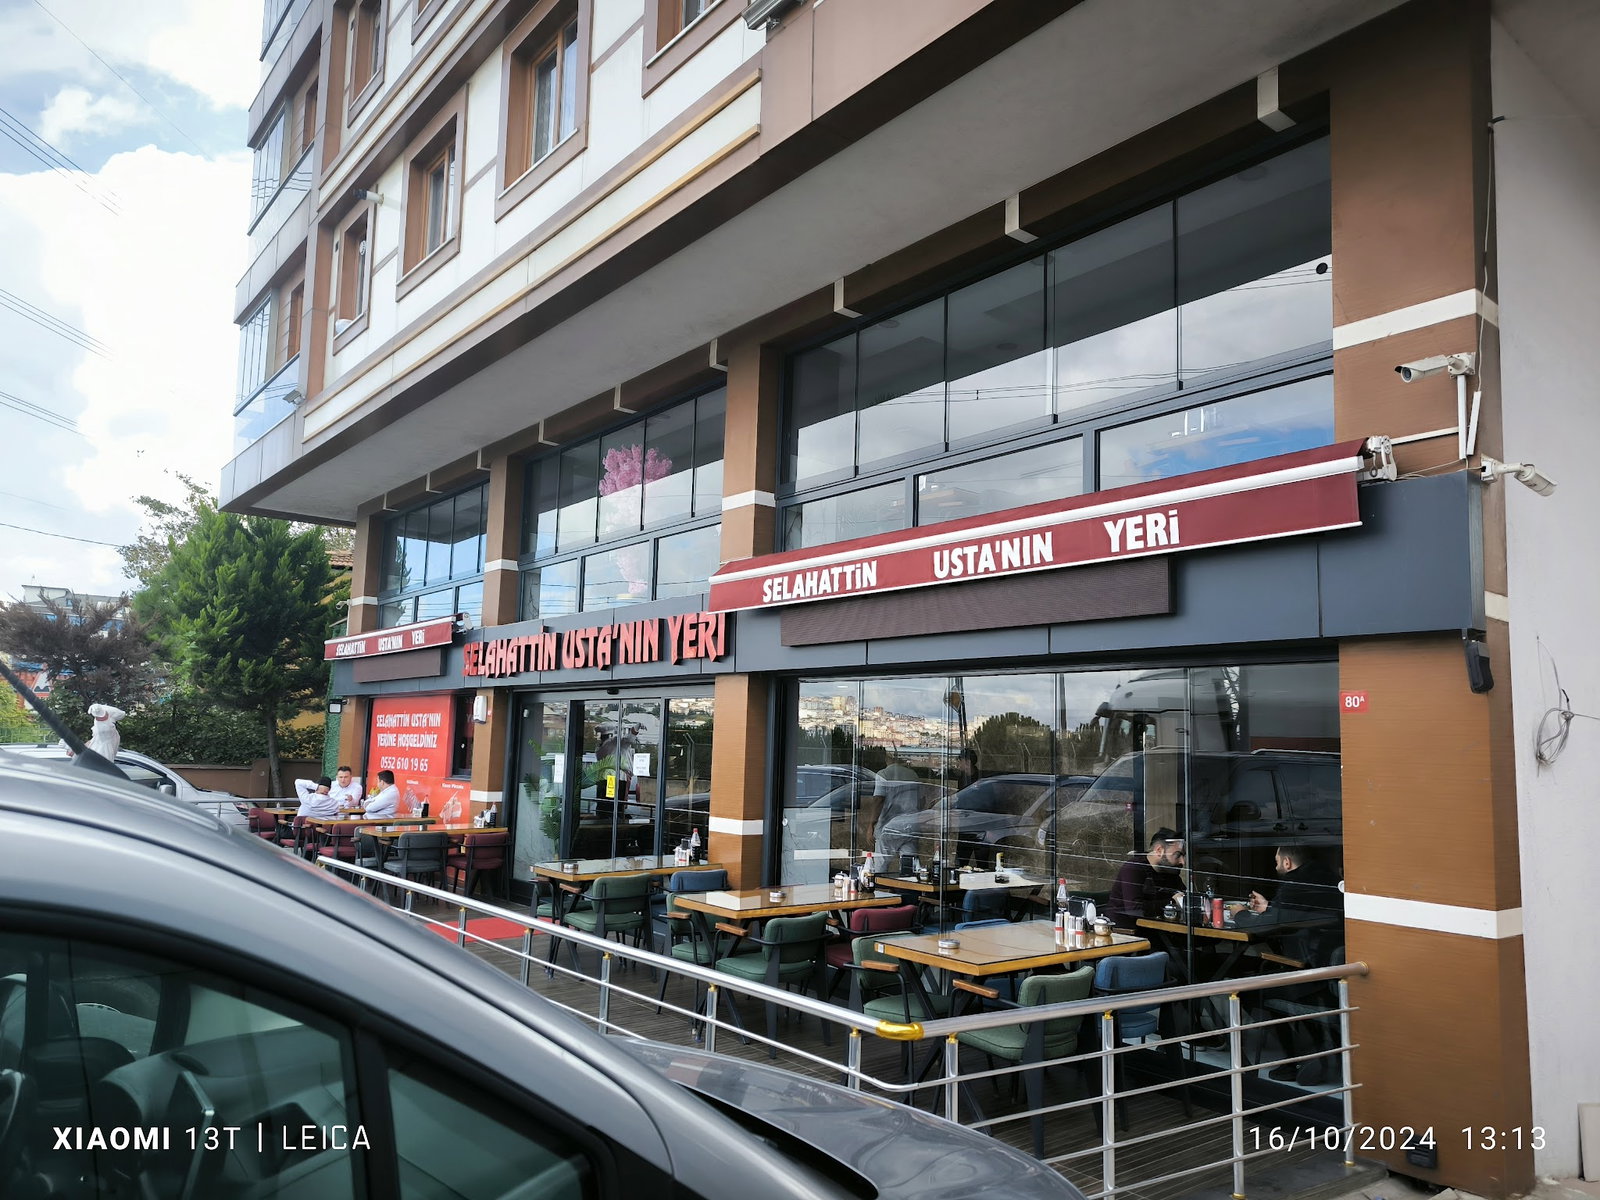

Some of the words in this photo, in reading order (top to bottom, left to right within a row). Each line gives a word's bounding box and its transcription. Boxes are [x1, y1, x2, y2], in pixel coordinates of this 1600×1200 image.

[933, 531, 1054, 579] USTA'NIN
[562, 618, 659, 670] USTA'NIN
[411, 713, 441, 728] USTA'NIN
[380, 756, 396, 769] 0552
[396, 757, 409, 770] 610
[411, 758, 419, 771] 19
[419, 758, 429, 772] 65
